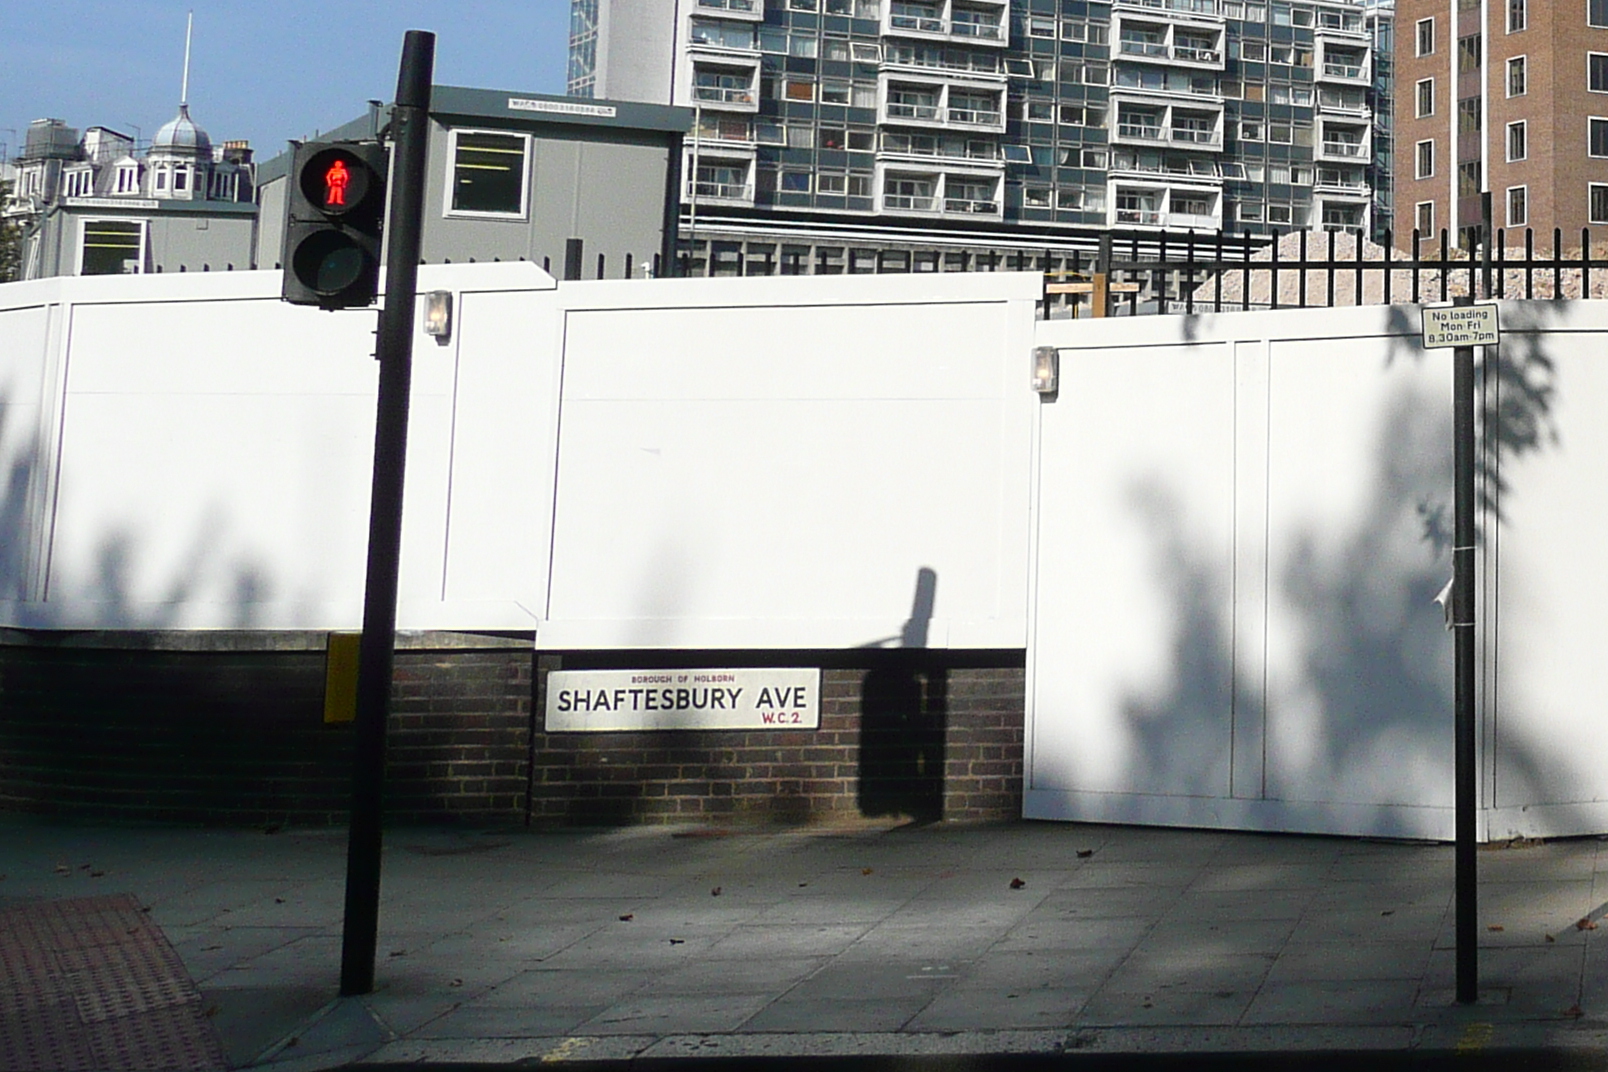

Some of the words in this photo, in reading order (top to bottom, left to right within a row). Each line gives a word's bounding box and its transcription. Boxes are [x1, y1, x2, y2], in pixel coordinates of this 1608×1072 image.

[1432, 312, 1447, 321] No
[1450, 310, 1488, 320] loading
[631, 675, 672, 684] BOROUGH
[677, 675, 688, 683] OF
[694, 674, 735, 683] HOLBORN
[557, 688, 743, 712] SHAFTESBURY
[755, 686, 807, 709] AVE
